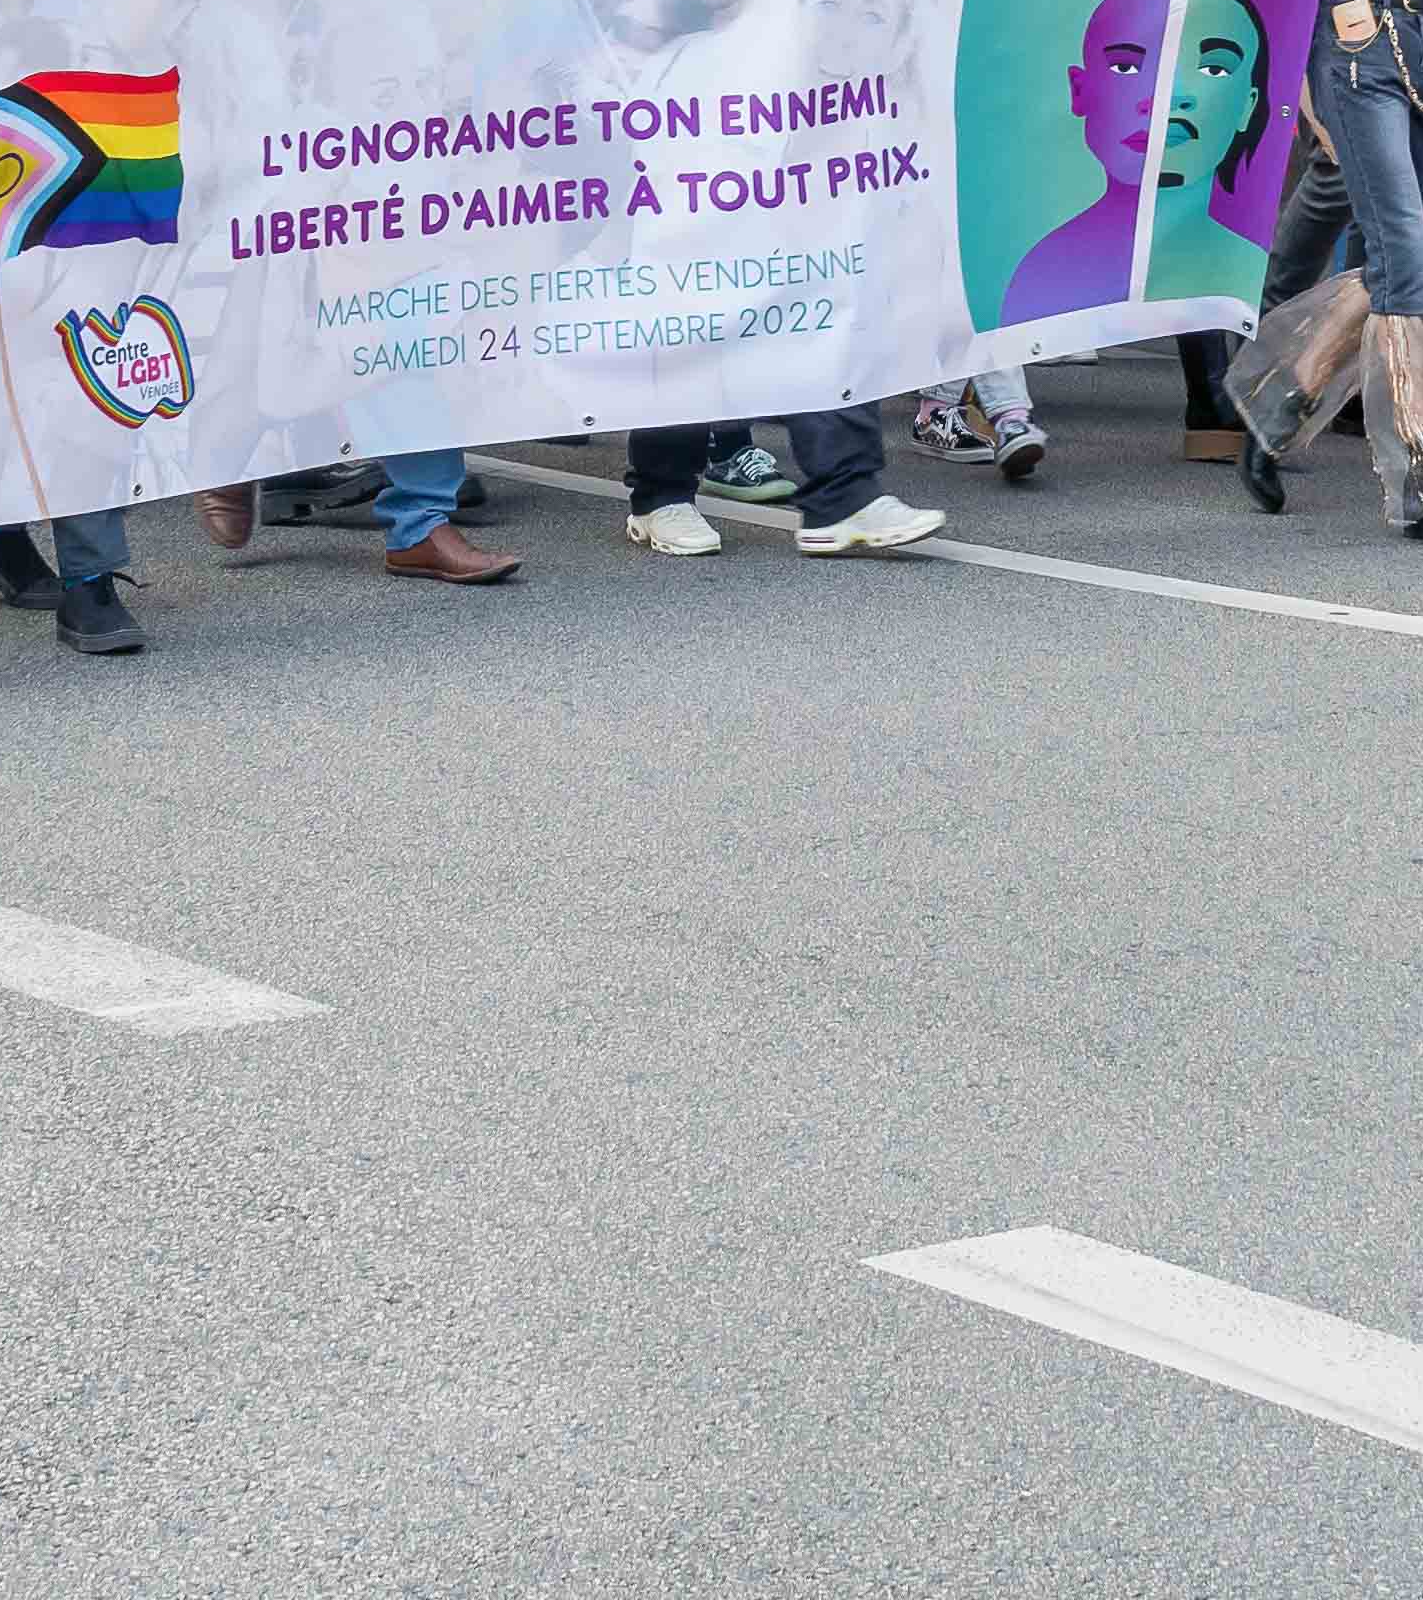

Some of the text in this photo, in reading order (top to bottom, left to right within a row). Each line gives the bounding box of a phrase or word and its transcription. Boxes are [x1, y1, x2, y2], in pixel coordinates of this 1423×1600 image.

[262, 74, 898, 177] L'IGNORANCE TON ENNEMI,
[231, 142, 930, 260] LIBERTÉ D'AIMER À TOUT PRIX.
[316, 243, 866, 328] MARCHE DES FIERTÉS VENDÉENNE
[91, 342, 149, 367] Centre
[117, 352, 171, 389] LGBT
[353, 298, 835, 376] SAMEDI 24 SEPTEMBRE 2022
[140, 380, 180, 400] VENDÉE
